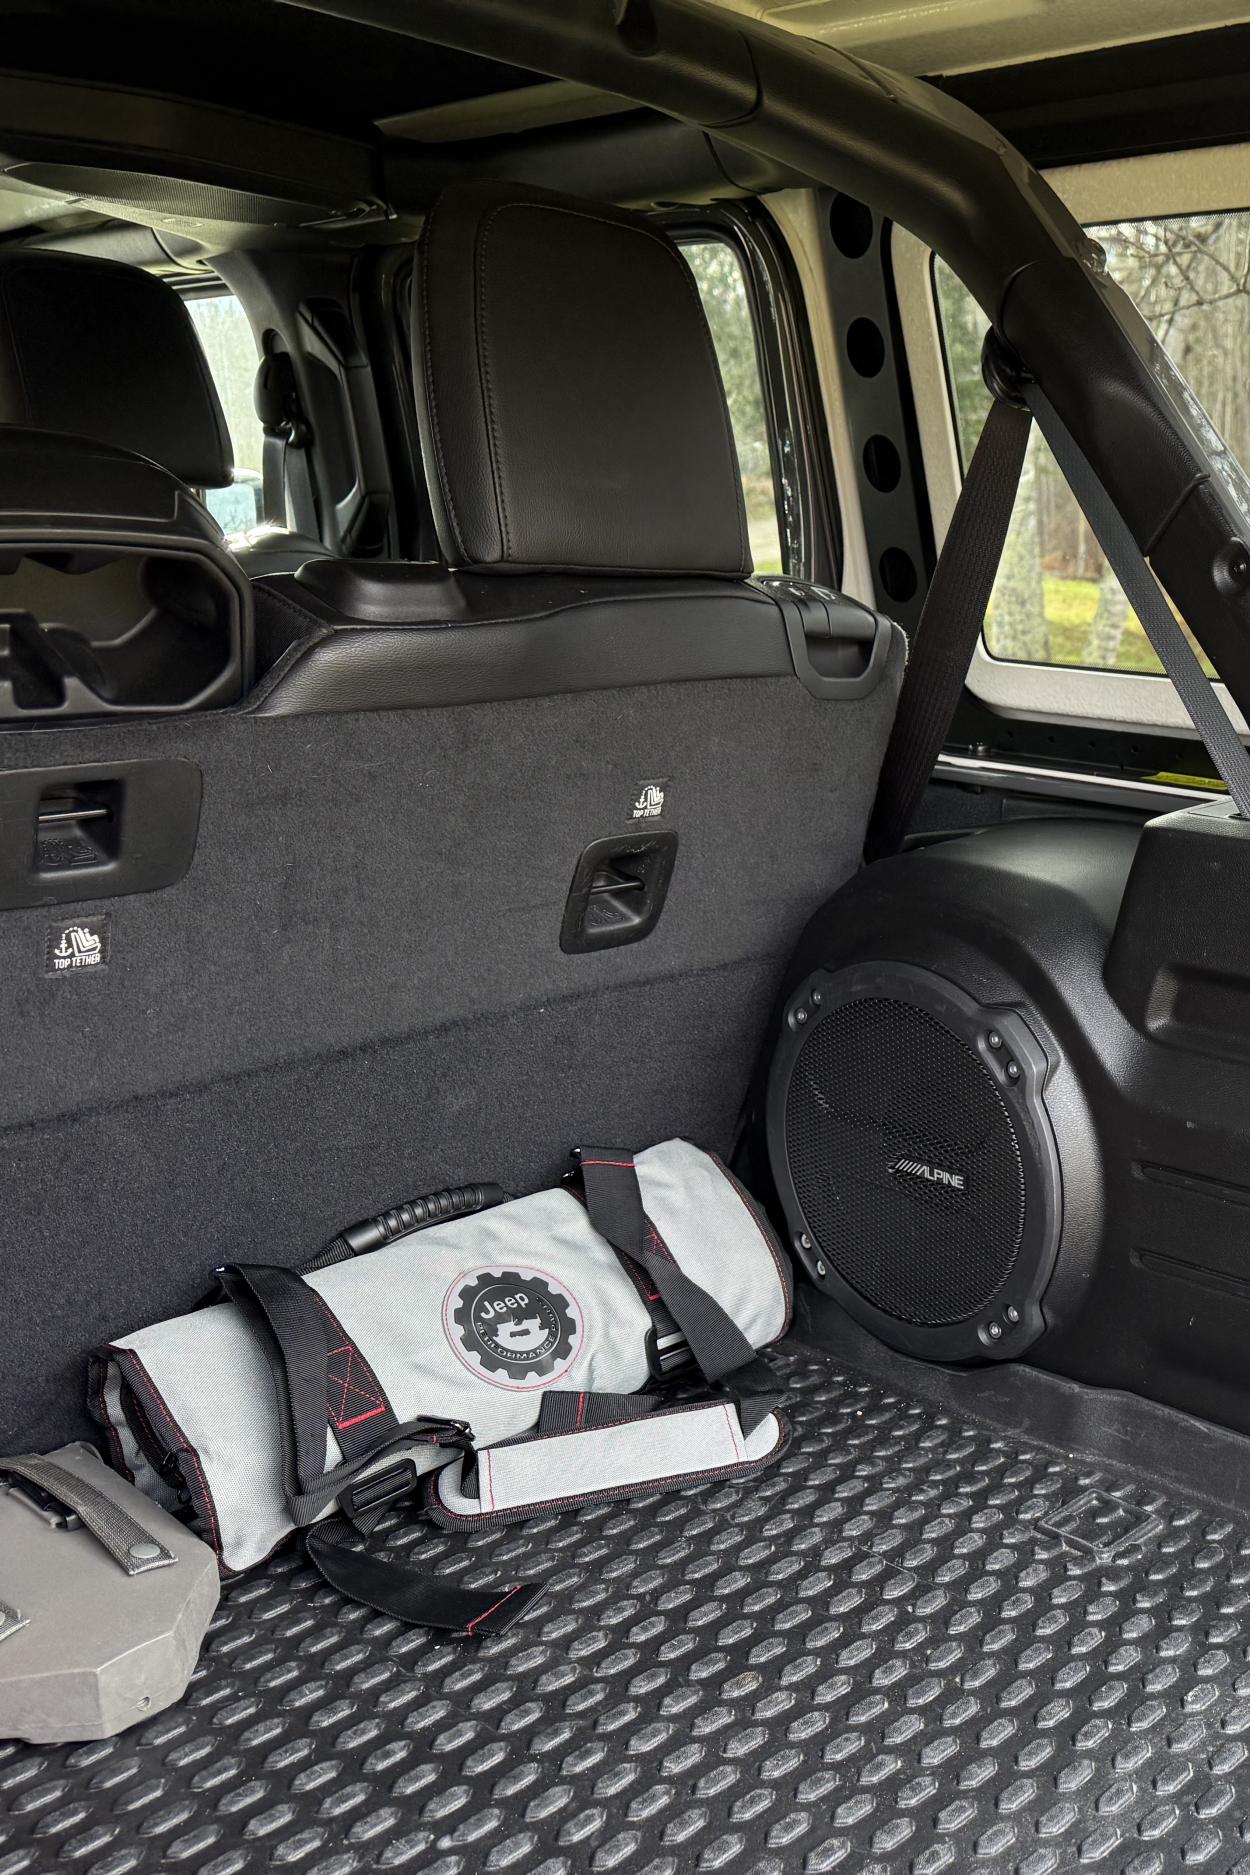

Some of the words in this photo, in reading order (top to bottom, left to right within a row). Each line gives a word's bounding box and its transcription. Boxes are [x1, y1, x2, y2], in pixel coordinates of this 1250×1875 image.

[633, 809, 644, 818] TOP
[644, 807, 662, 817] TETHER
[54, 958, 70, 969] TOP
[72, 953, 100, 966] TETHER
[912, 1163, 964, 1189] ALPINE
[480, 1292, 529, 1319] Jeep
[477, 1322, 555, 1359] PERFORMANCE
